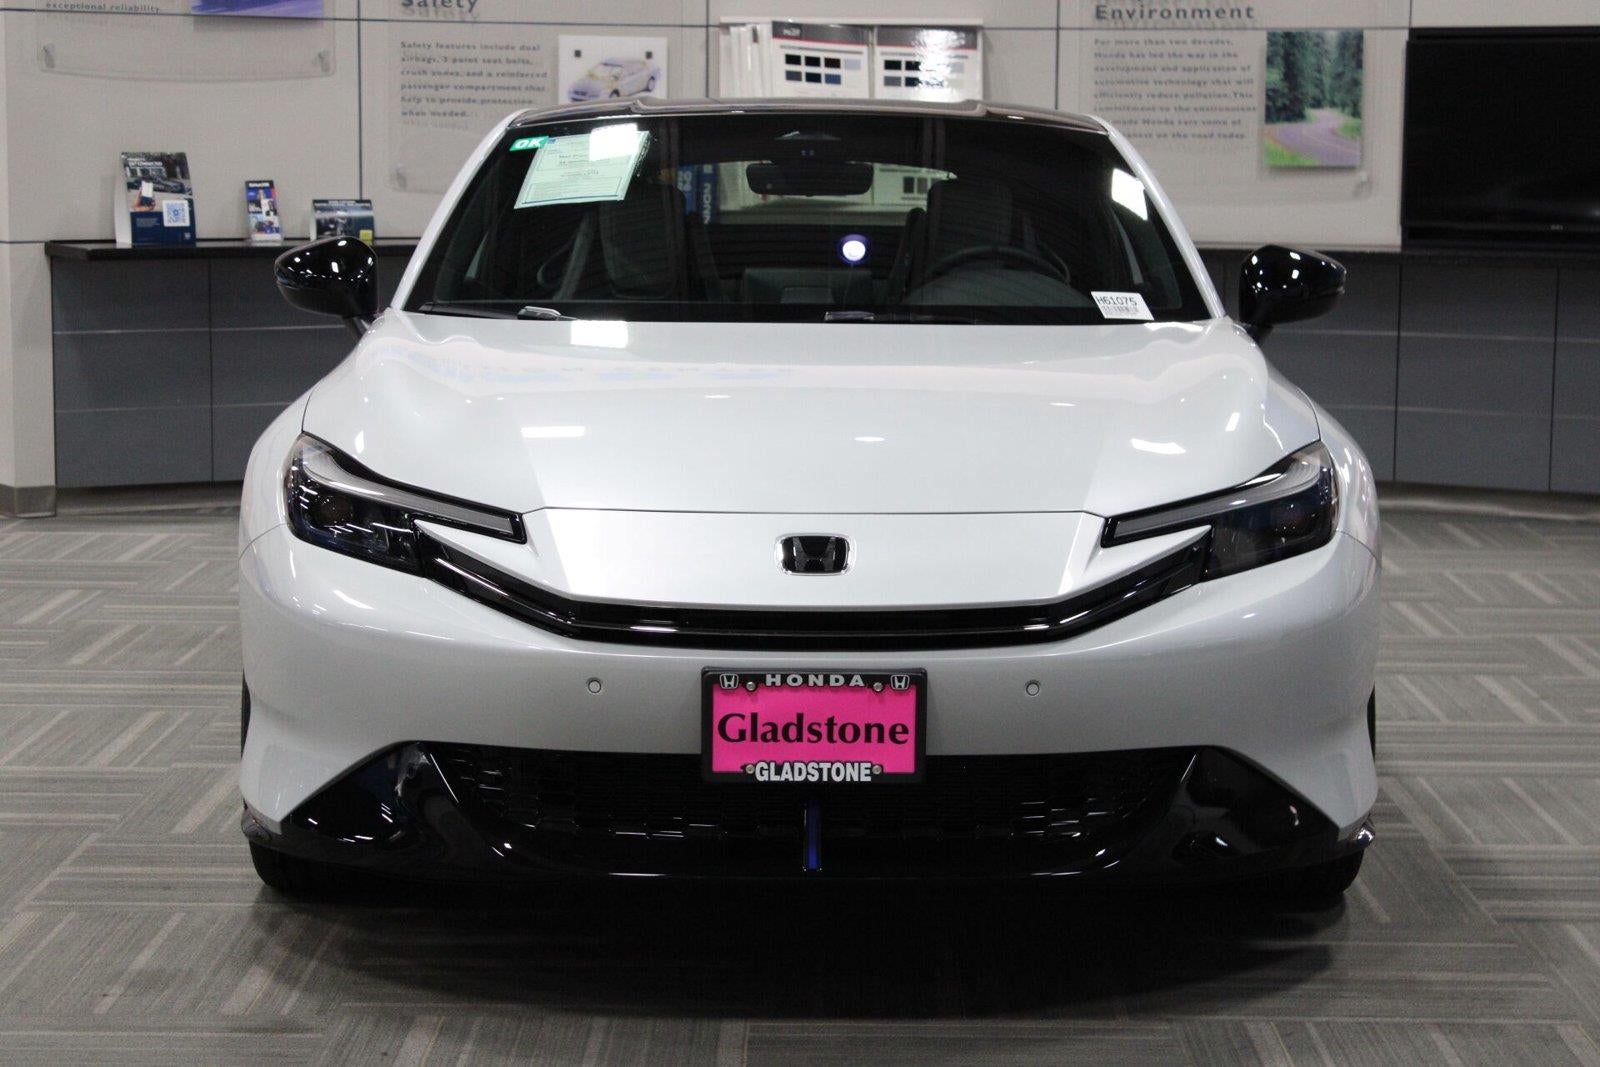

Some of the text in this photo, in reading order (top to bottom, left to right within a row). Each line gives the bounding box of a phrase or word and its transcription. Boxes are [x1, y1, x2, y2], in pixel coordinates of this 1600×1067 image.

[46, 2, 161, 14] exceptional reliability
[1095, 4, 1255, 20] Environment
[400, 41, 541, 51] Safety features include dual
[401, 83, 545, 92] passenger compartment that
[401, 95, 422, 105] help
[439, 96, 478, 105] provide
[401, 109, 427, 118] when
[514, 137, 545, 149] OK
[765, 674, 865, 687] HONDA
[717, 712, 909, 744] Gladstone
[755, 762, 872, 782] GLADSTONE
